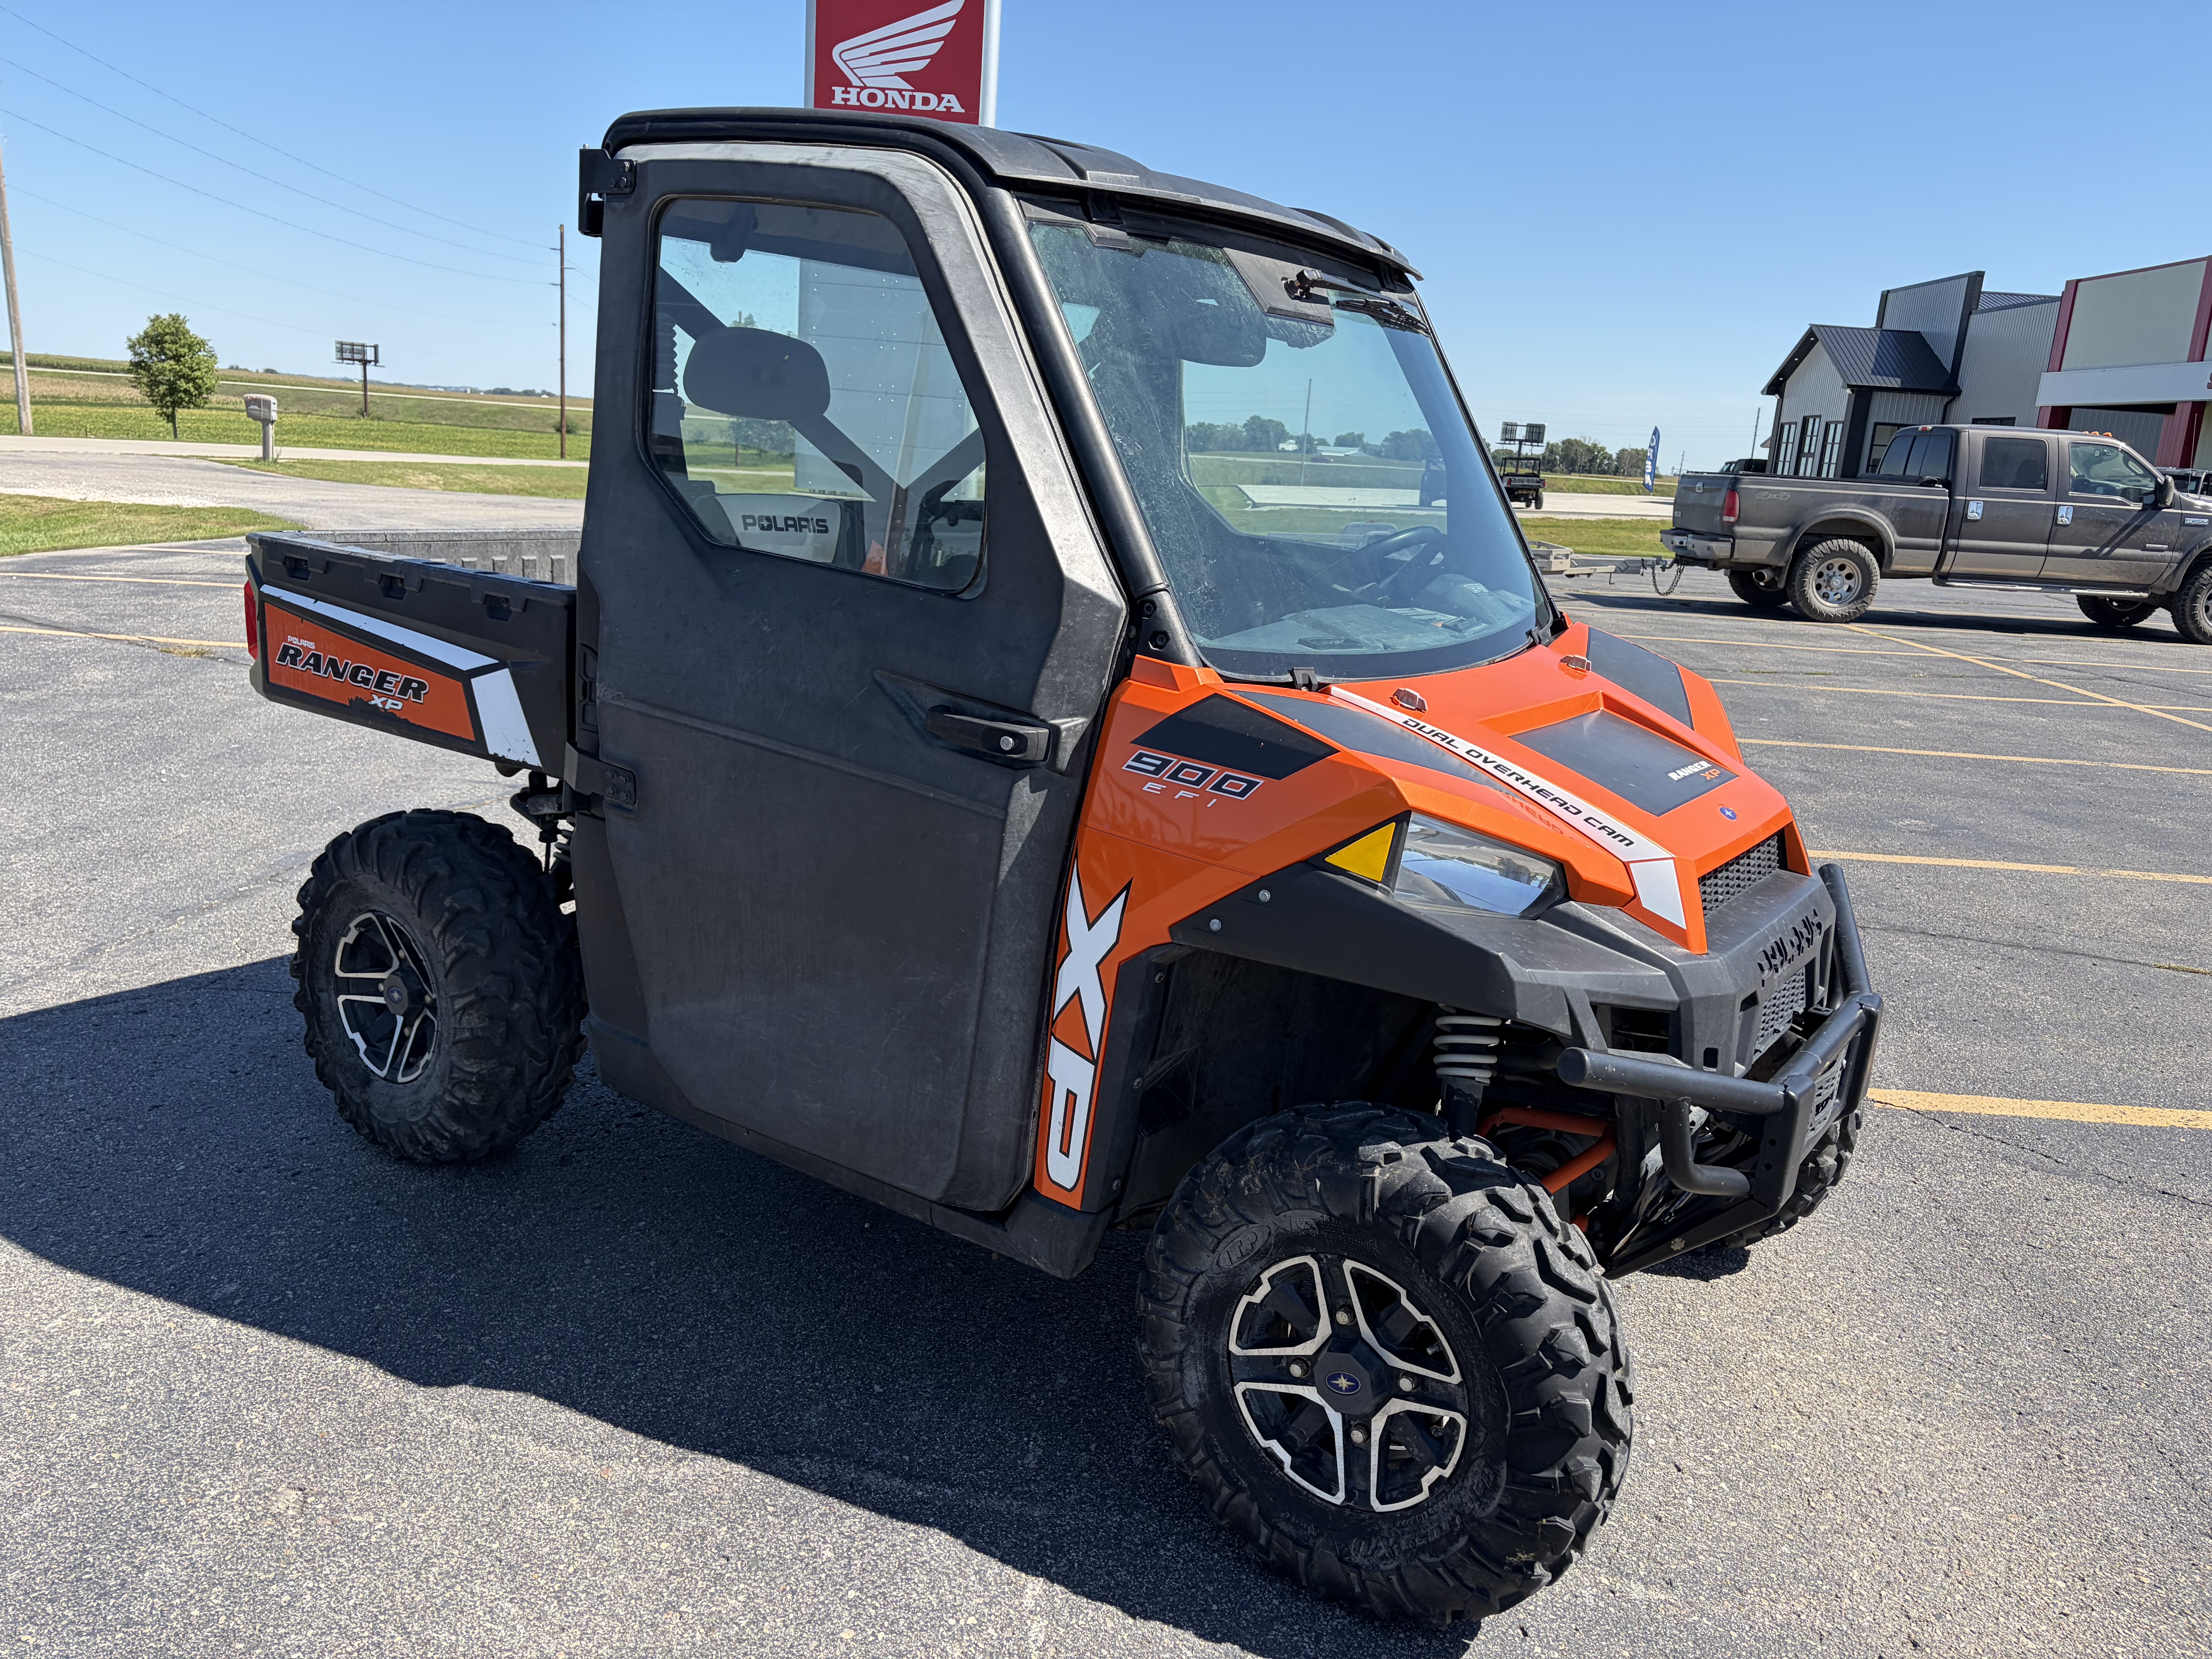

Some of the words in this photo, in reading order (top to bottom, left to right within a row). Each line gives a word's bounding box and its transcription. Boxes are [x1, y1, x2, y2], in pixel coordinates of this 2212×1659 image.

[831, 86, 965, 113] HONDA
[741, 515, 829, 534] POLARIS
[287, 635, 315, 649] POLARIS
[276, 642, 428, 703] RANGER
[368, 694, 404, 711] XP
[1121, 750, 1265, 800] 900
[1402, 718, 1459, 749] DUAL
[1465, 749, 1582, 815] OVERHEAD
[1583, 816, 1635, 847] CAM
[1667, 760, 1712, 781] RANGER
[1700, 768, 1721, 780] XP
[1142, 781, 1218, 807] EFI
[1046, 851, 1134, 1193] XP
